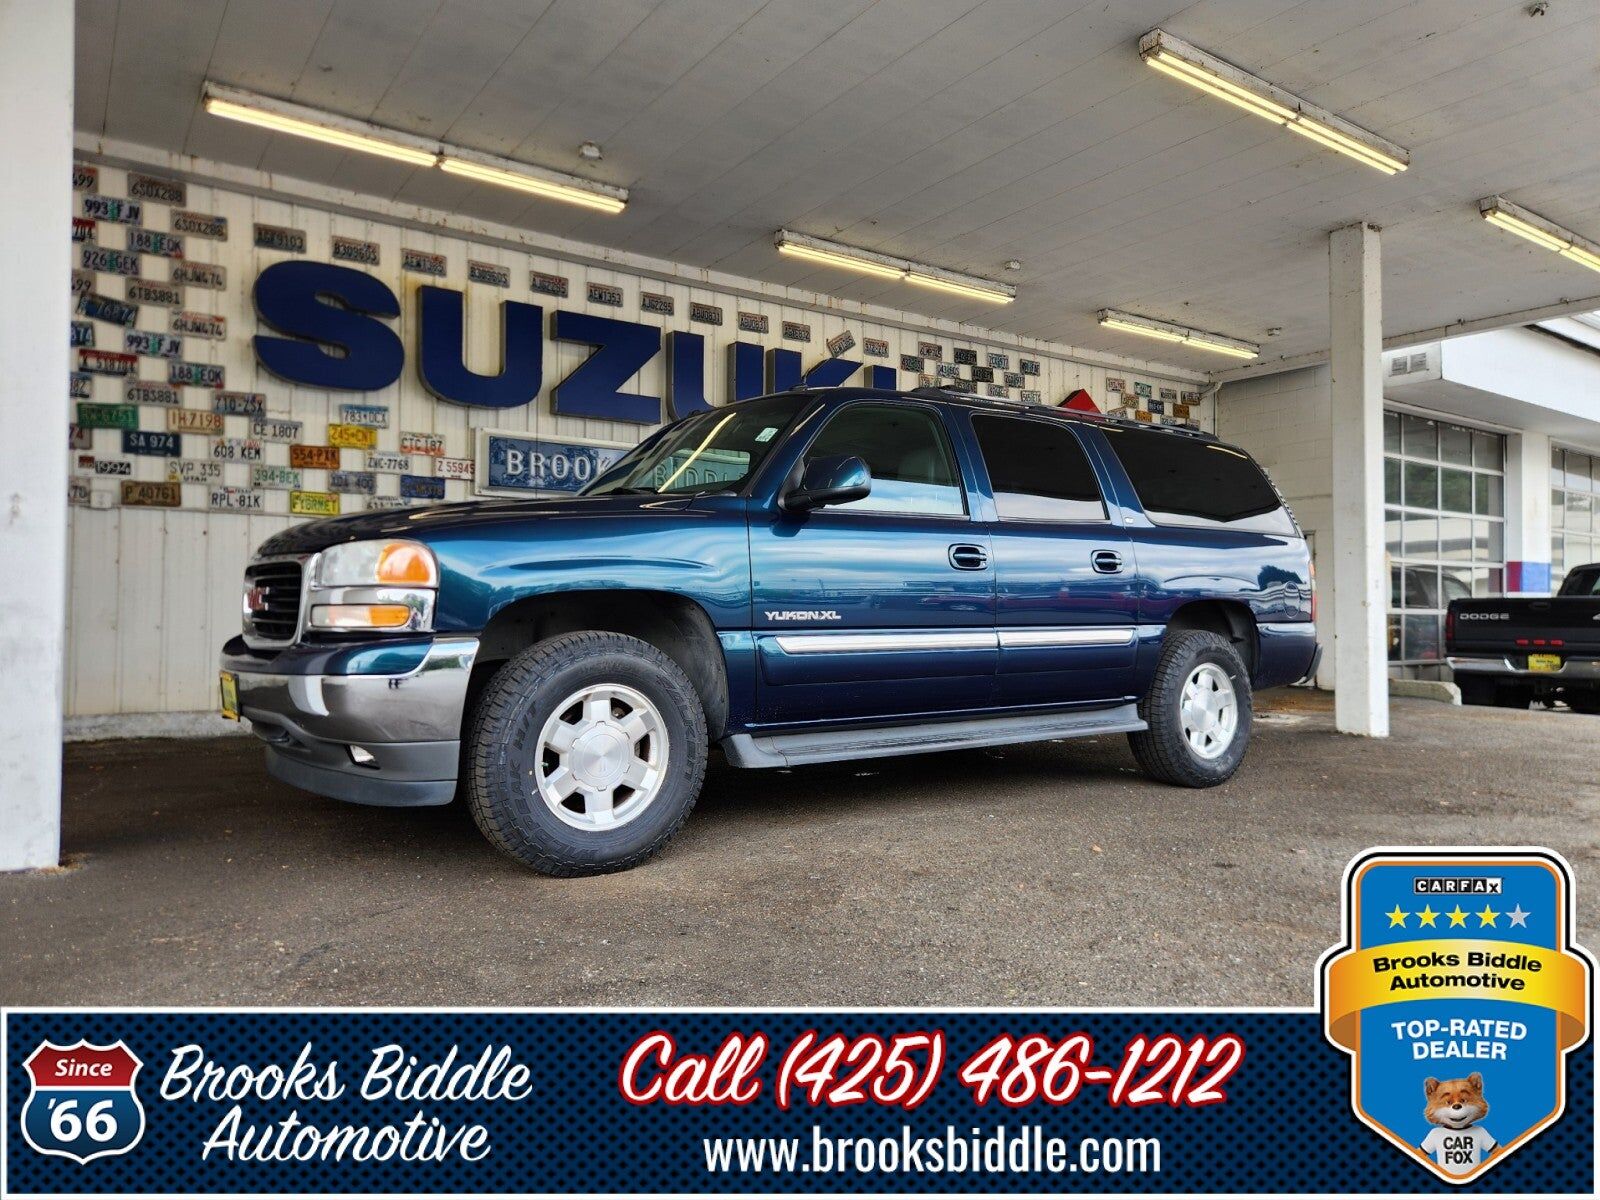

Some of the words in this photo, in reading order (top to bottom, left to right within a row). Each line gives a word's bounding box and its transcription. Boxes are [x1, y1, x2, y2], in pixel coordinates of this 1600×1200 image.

[85, 199, 109, 215] 993
[130, 232, 151, 247] 188
[83, 250, 108, 267] 926
[127, 335, 150, 350] 993
[172, 365, 193, 379] 188
[253, 423, 269, 436] CE
[271, 424, 298, 438] 1807
[129, 434, 147, 447] SA
[149, 436, 174, 448] 974
[214, 445, 234, 459] 608
[169, 462, 195, 476] SVP
[199, 464, 221, 478] 335
[437, 460, 444, 472] Z
[506, 449, 618, 482] BROOK
[764, 610, 819, 621] YUKON
[820, 610, 842, 621] XL
